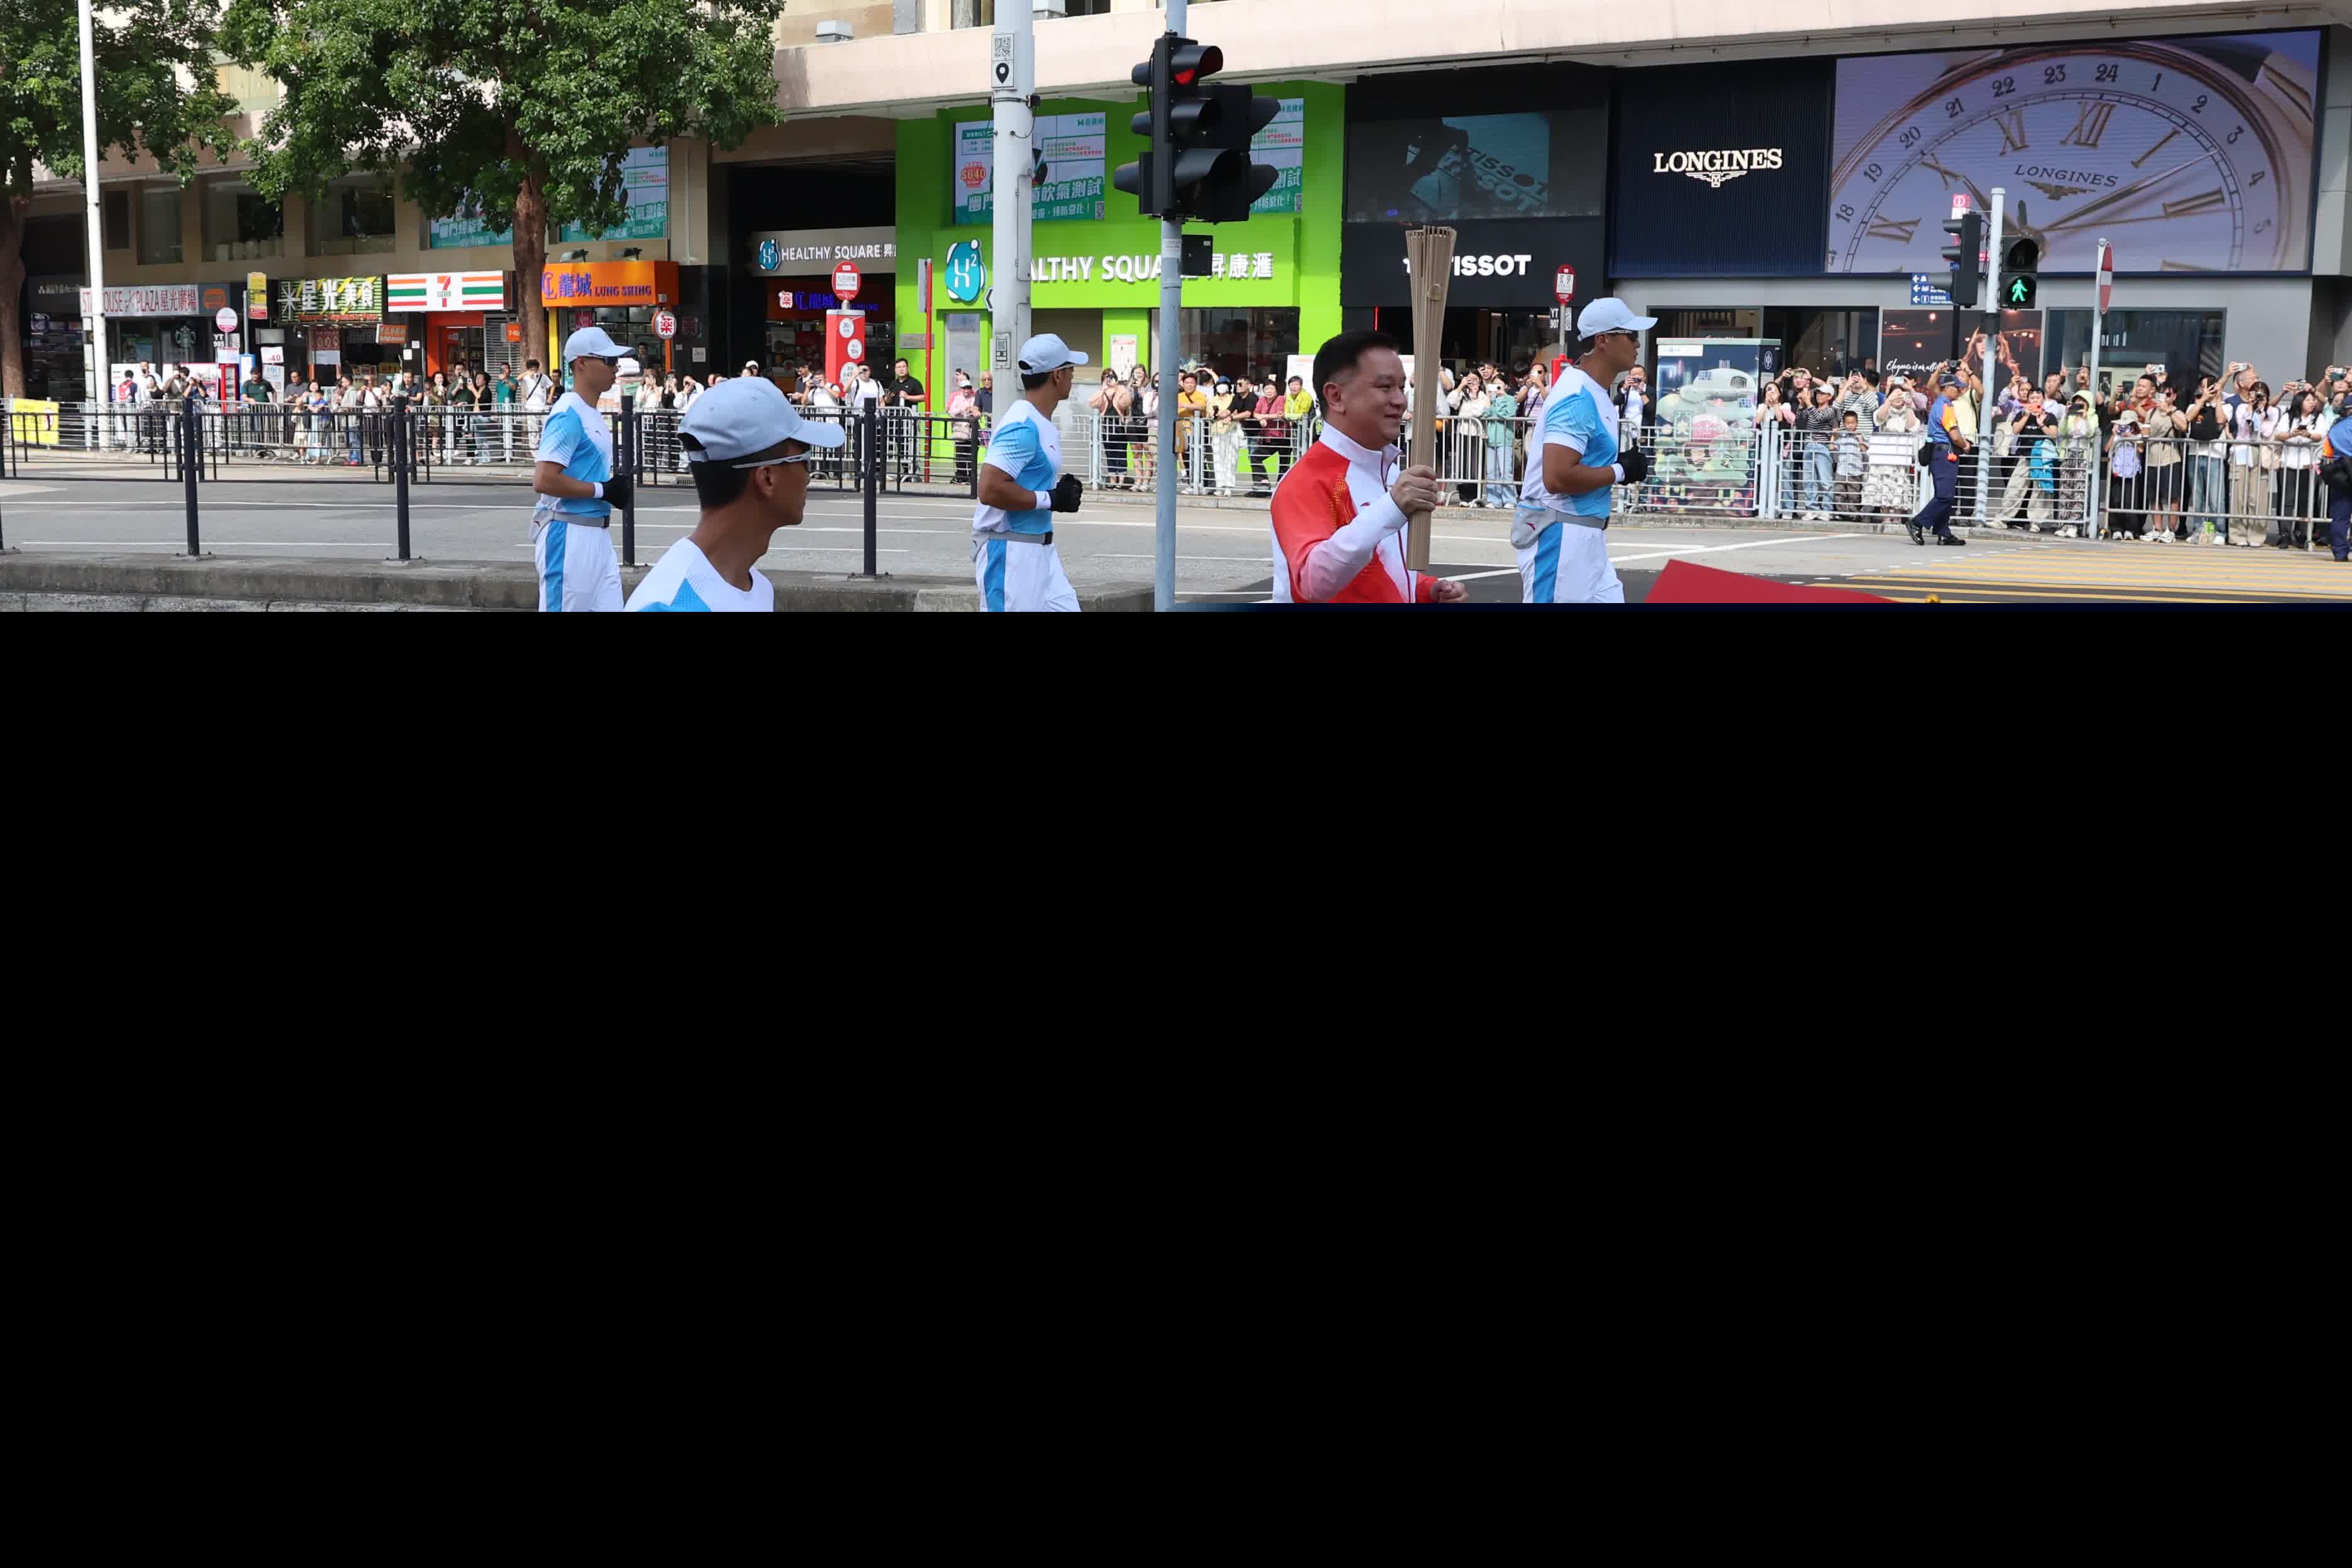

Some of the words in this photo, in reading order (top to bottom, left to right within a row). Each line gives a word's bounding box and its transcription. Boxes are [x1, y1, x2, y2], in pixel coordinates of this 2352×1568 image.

[2044, 64, 2066, 84] 23
[2095, 63, 2118, 82] 24
[1991, 76, 2015, 97] 22
[1946, 97, 1964, 118] 21
[2191, 95, 2208, 113] 2
[1900, 126, 1921, 149] 20
[2226, 126, 2244, 144] 3
[1653, 148, 1783, 173] LONGINES
[1863, 162, 1883, 183] 19
[2015, 164, 2118, 187] LONGINES
[1835, 204, 1855, 223] 18
[781, 248, 832, 261] HEALTHY
[834, 244, 880, 259] SQUARE
[1031, 257, 1093, 281] ALTHY
[1452, 254, 1532, 276] ISSOT
[302, 279, 373, 311] 星光美食
[559, 273, 592, 298] 龍城
[594, 286, 619, 297] LUNG
[622, 285, 651, 297] SHING
[102, 291, 124, 312] OUSE
[136, 290, 159, 312] PLAZA
[160, 288, 197, 312] 星光廣場
[1550, 308, 1559, 317] YT
[1550, 318, 1559, 329] 907
